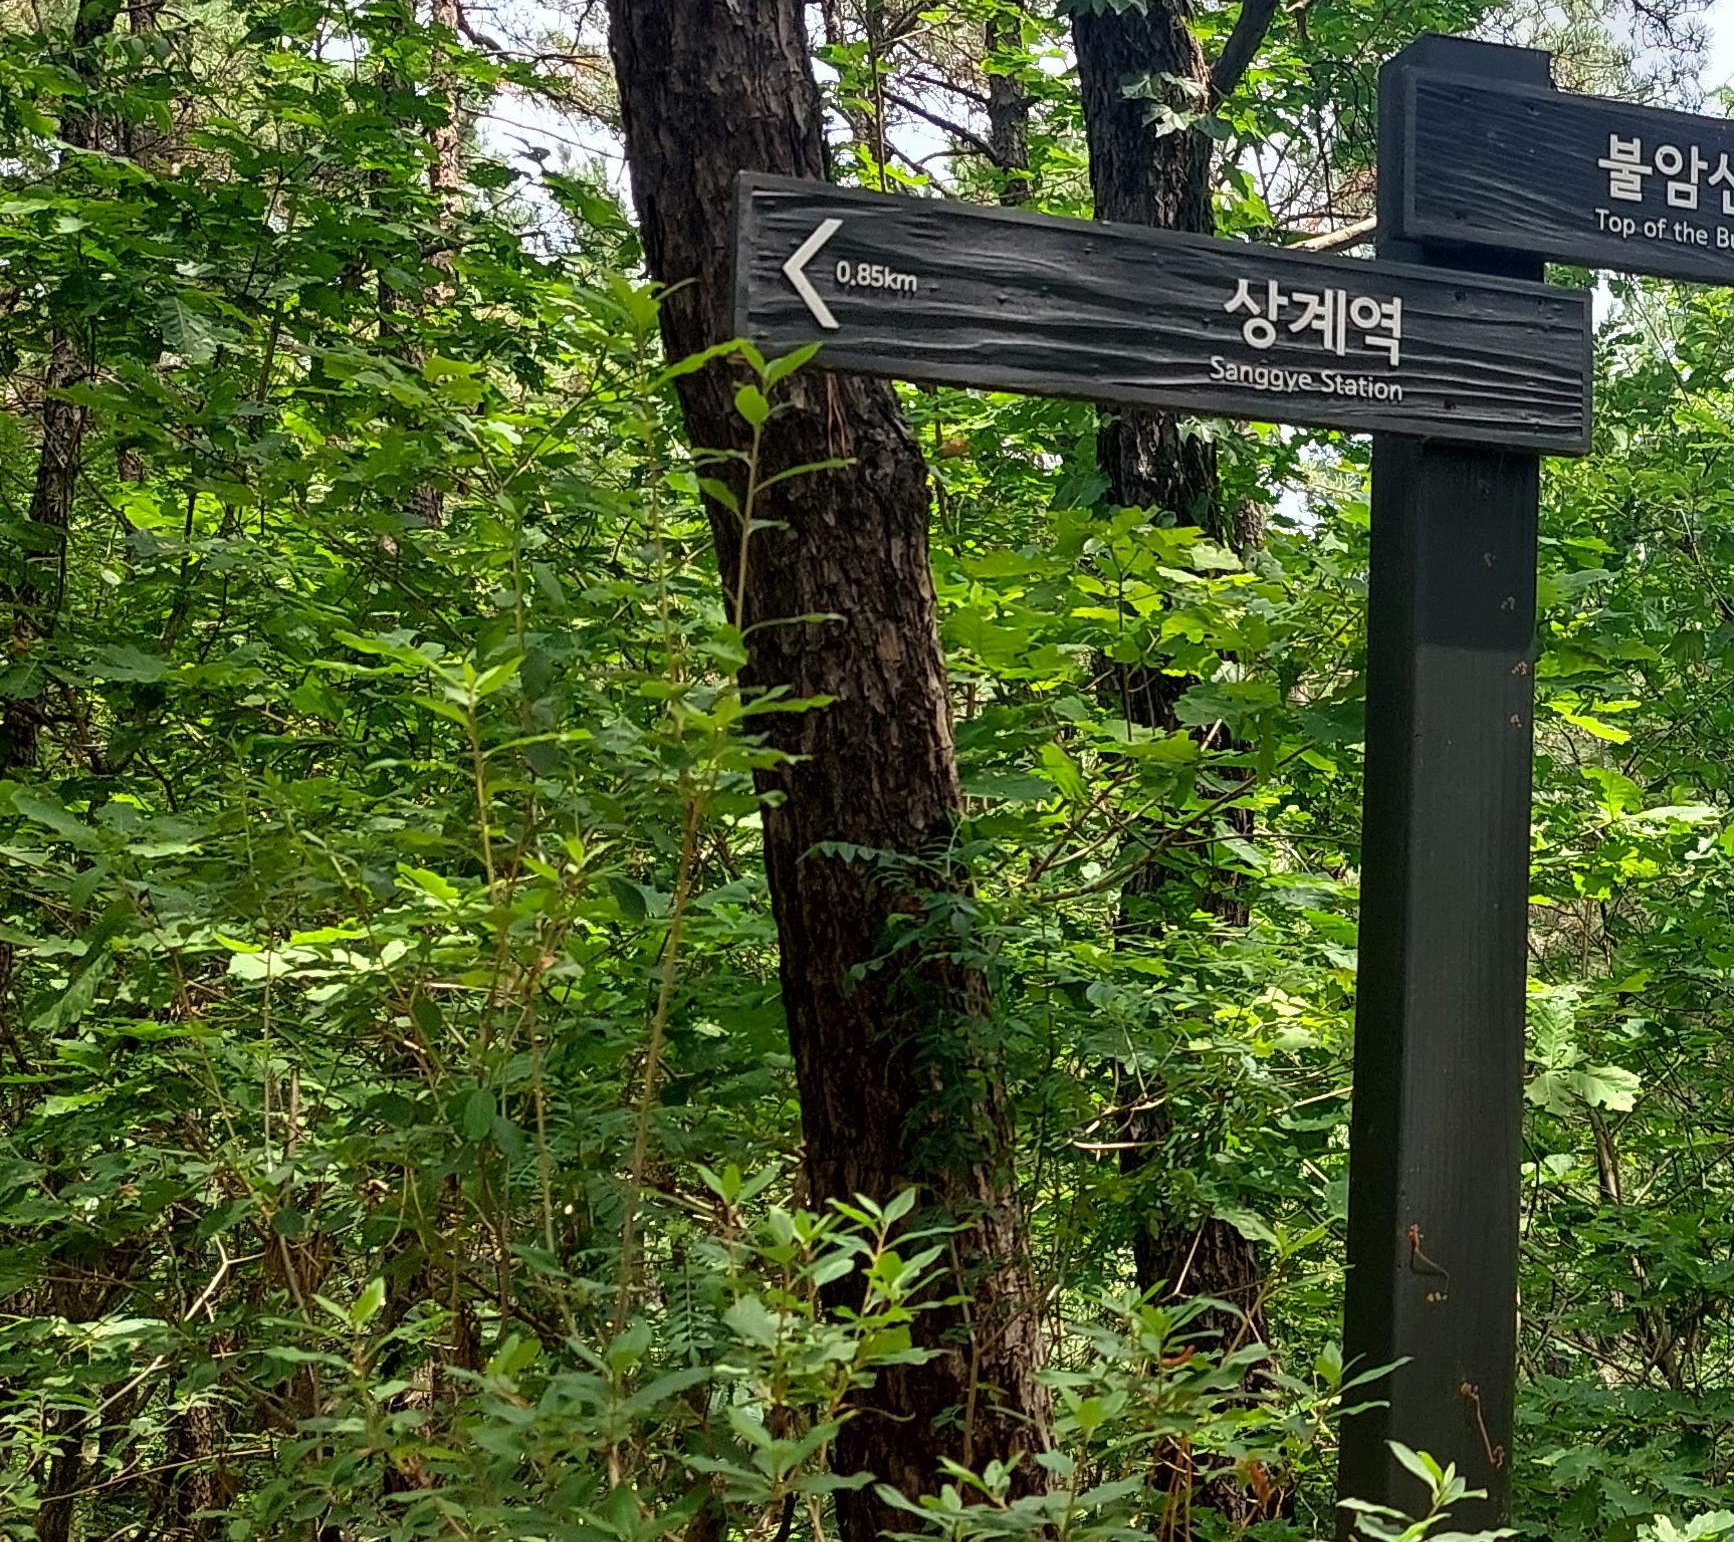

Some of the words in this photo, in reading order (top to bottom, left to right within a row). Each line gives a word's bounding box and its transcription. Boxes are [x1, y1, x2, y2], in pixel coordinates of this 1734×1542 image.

[1595, 207, 1636, 240] Top
[1644, 215, 1669, 241] of
[1673, 218, 1709, 247] the
[836, 261, 917, 292] 0.85km
[1225, 279, 1402, 366] 상계역
[1210, 356, 1313, 393] Sanggye
[1321, 370, 1403, 401] Station
